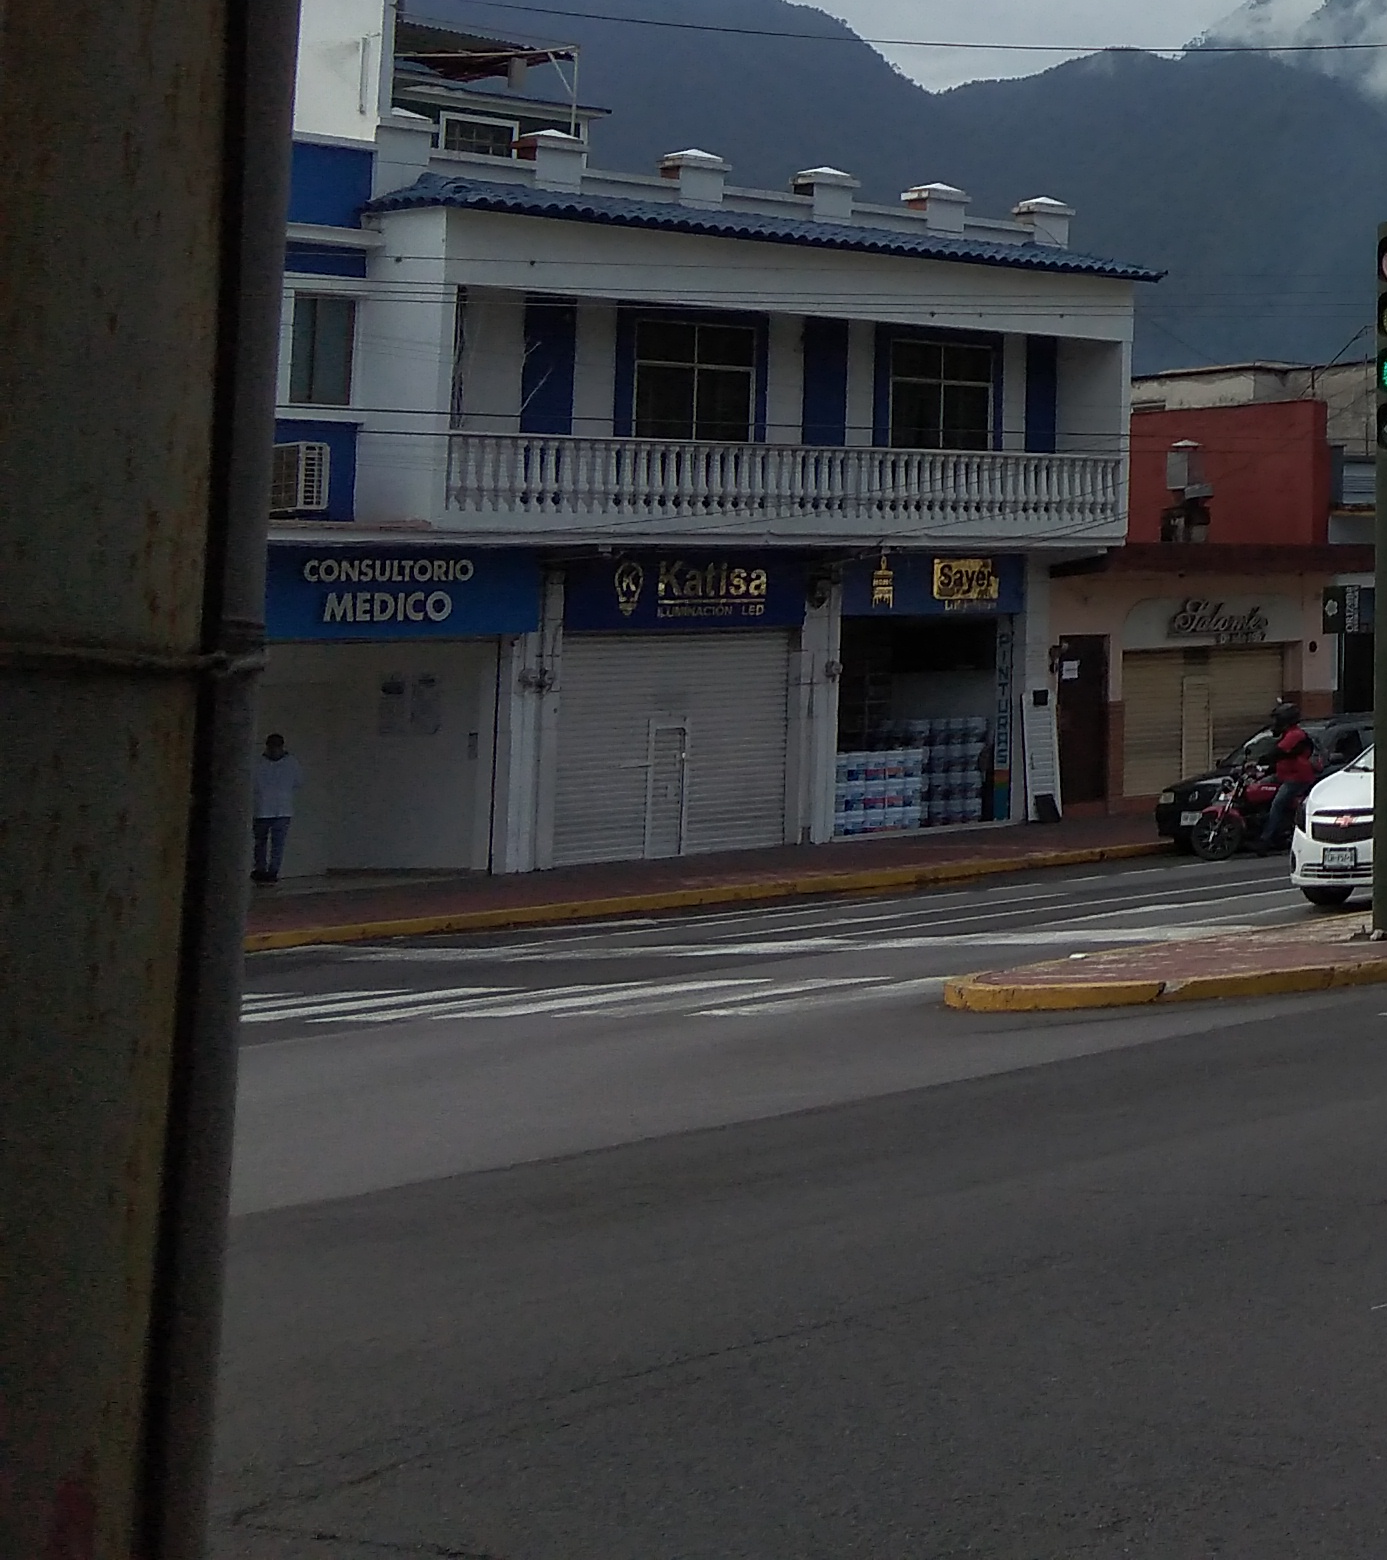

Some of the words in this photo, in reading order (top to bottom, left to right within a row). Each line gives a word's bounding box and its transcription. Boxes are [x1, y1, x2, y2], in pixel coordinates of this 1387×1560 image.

[303, 559, 475, 582] CONSULTORIO
[657, 561, 767, 597] Katisa
[323, 590, 453, 622] MEDICO
[741, 604, 765, 616] LED
